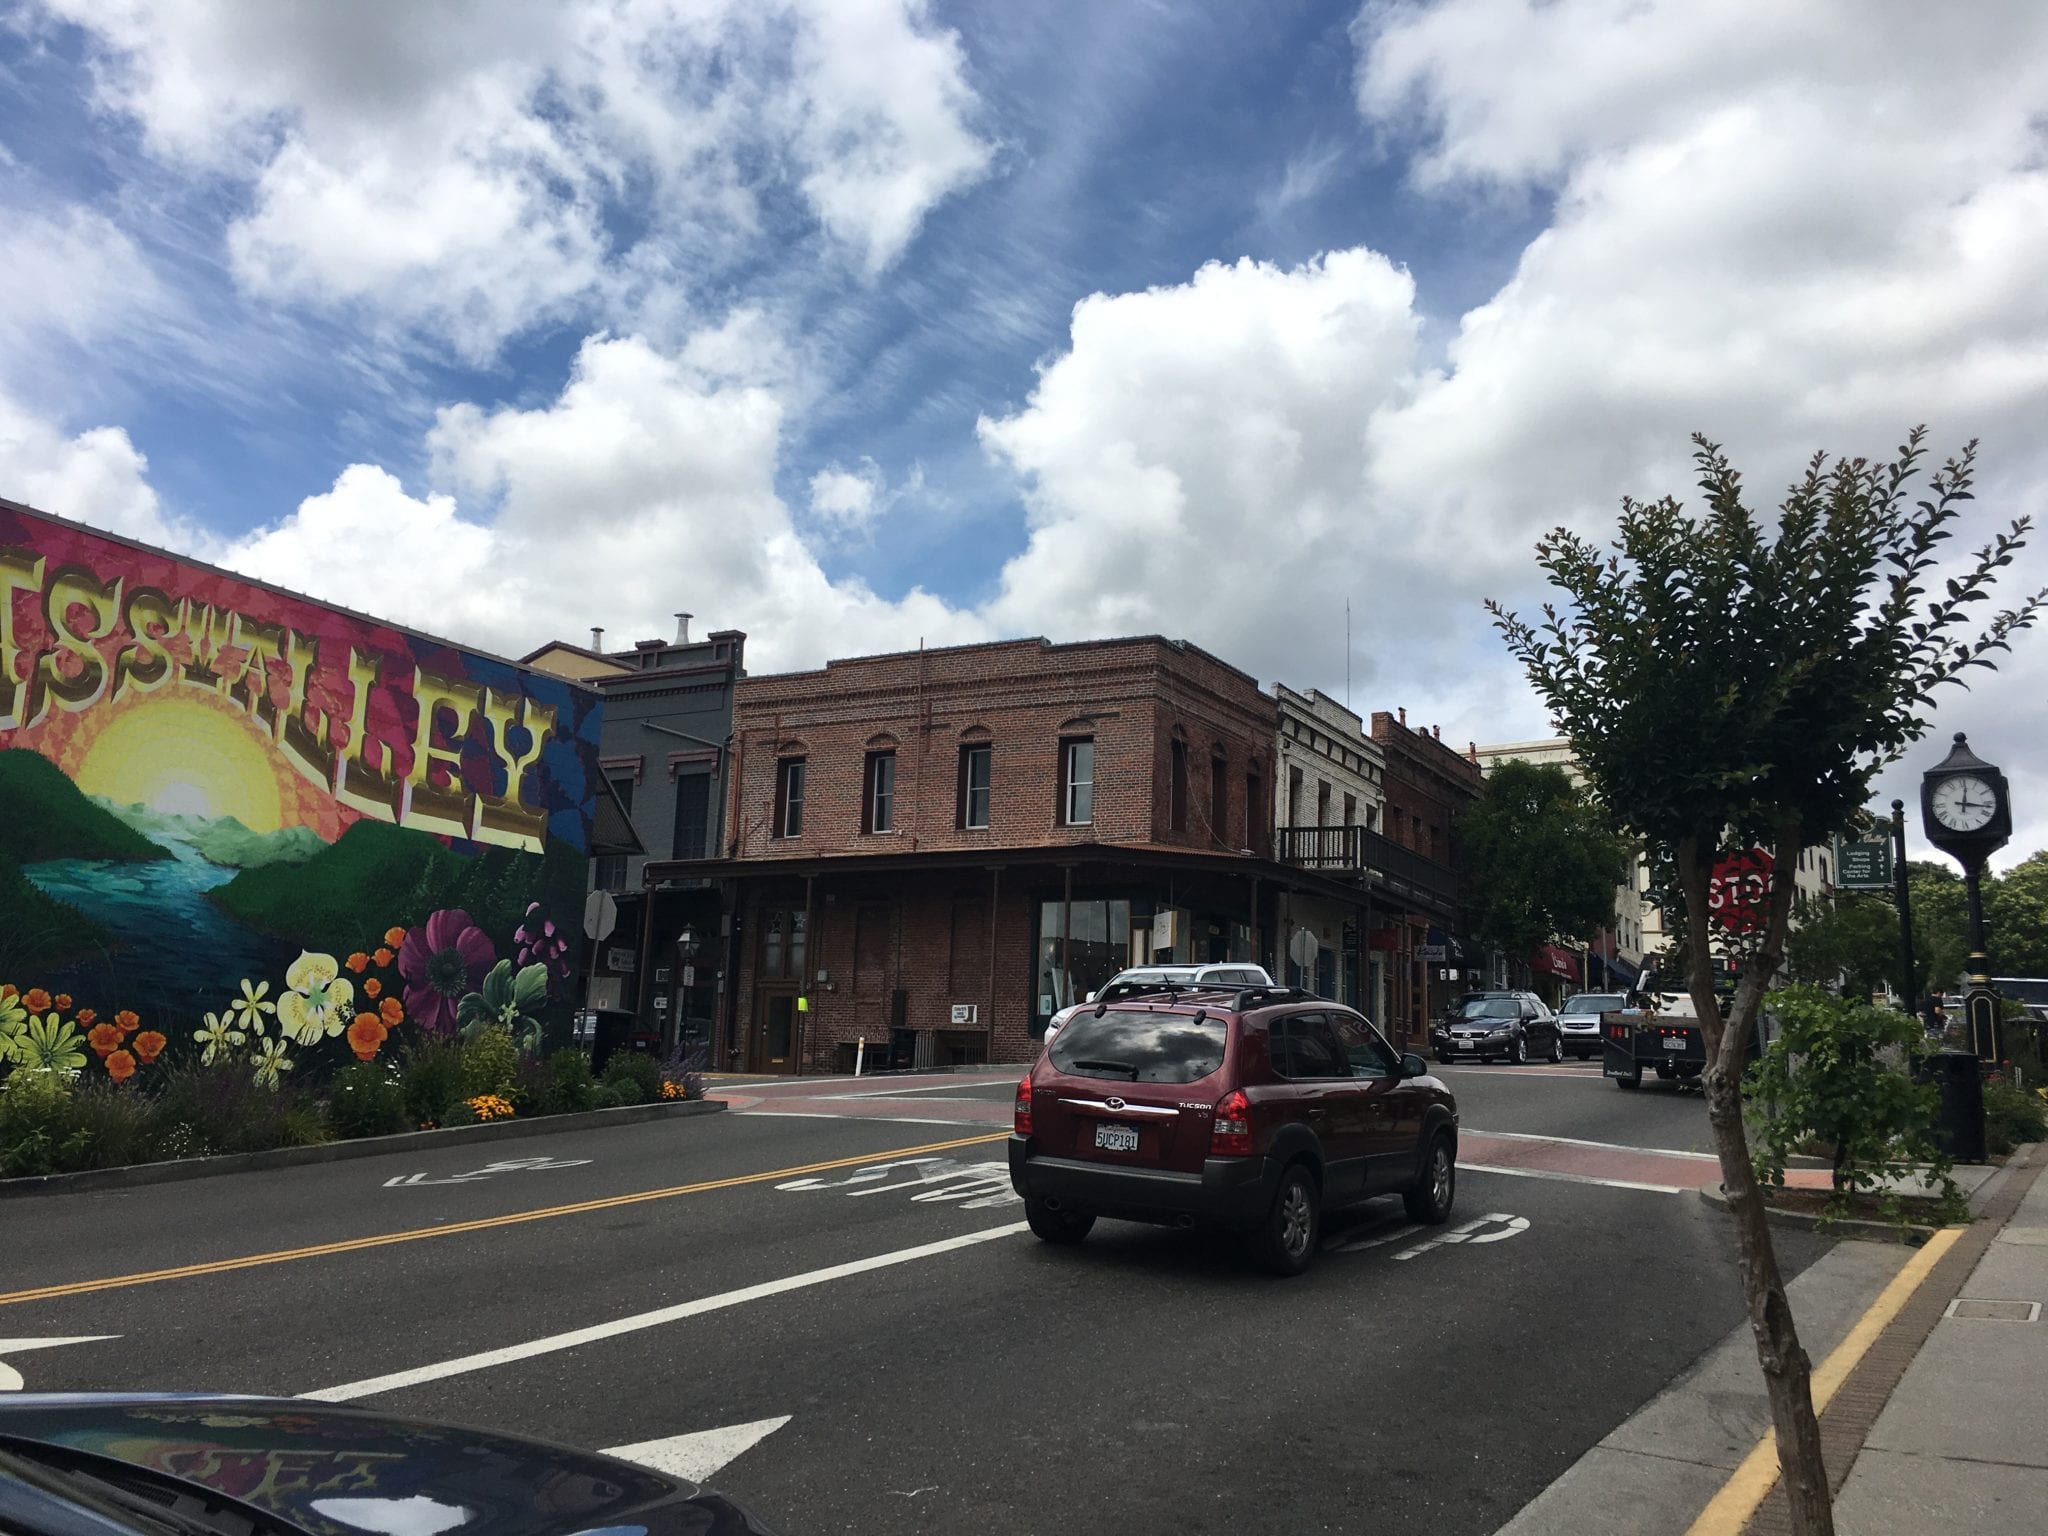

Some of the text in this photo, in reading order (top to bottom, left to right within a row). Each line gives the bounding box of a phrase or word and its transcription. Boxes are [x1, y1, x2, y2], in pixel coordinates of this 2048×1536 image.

[178, 596, 557, 855] VALLEY
[1178, 1102, 1212, 1110] TUCSON
[1097, 1131, 1135, 1148] 5UCP181
